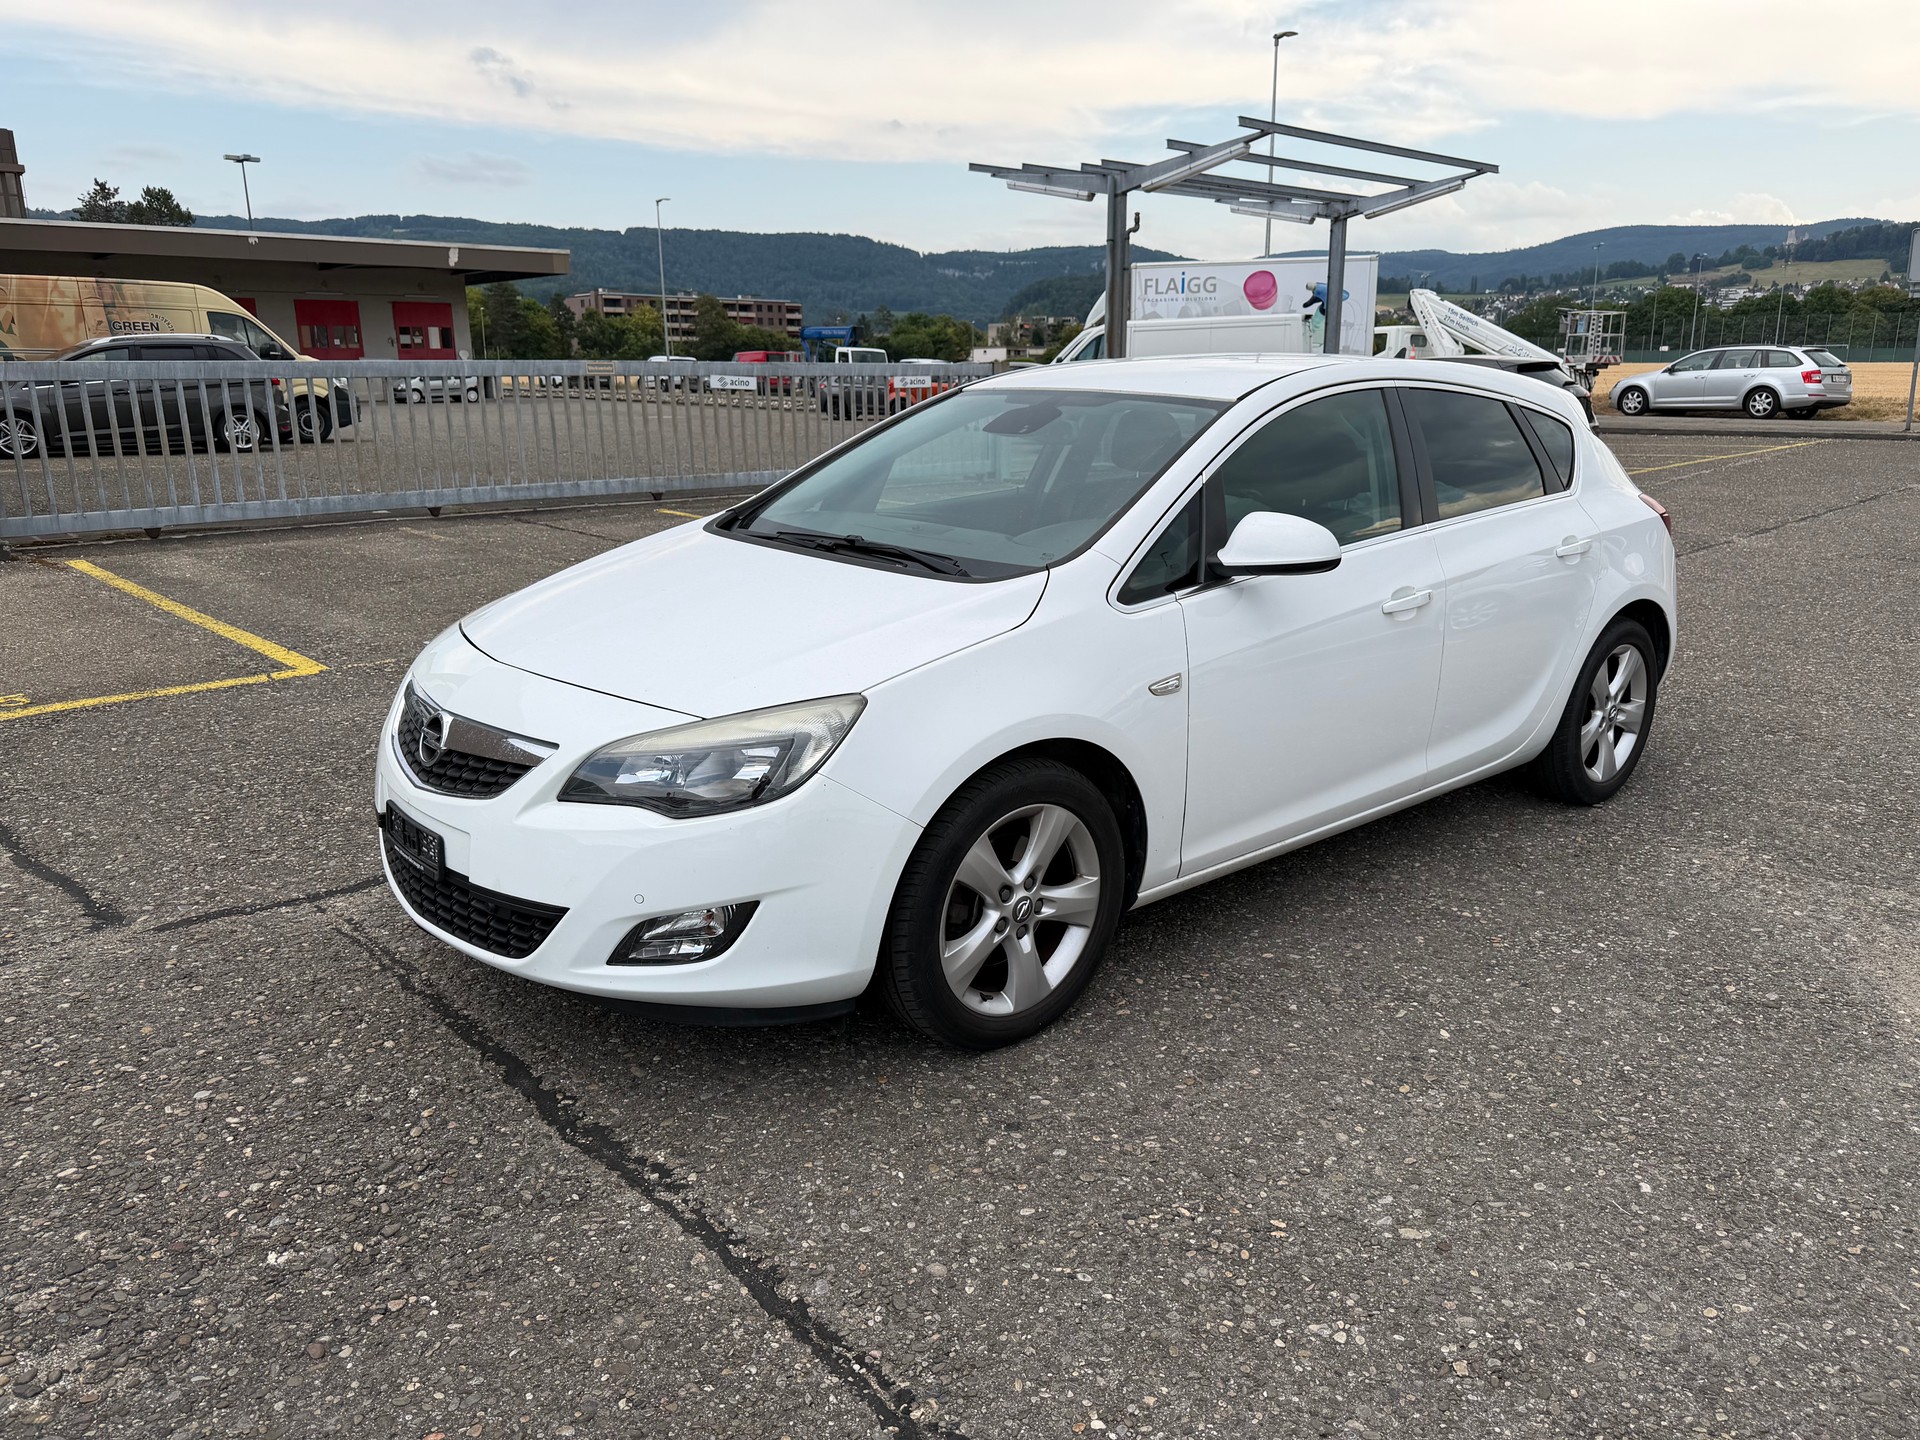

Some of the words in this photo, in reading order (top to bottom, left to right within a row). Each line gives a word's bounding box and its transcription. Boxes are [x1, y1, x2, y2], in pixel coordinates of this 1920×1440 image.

[1143, 271, 1217, 295] FLAiGG
[112, 321, 160, 332] GREEN
[729, 377, 750, 387] acino
[909, 377, 926, 385] acino
